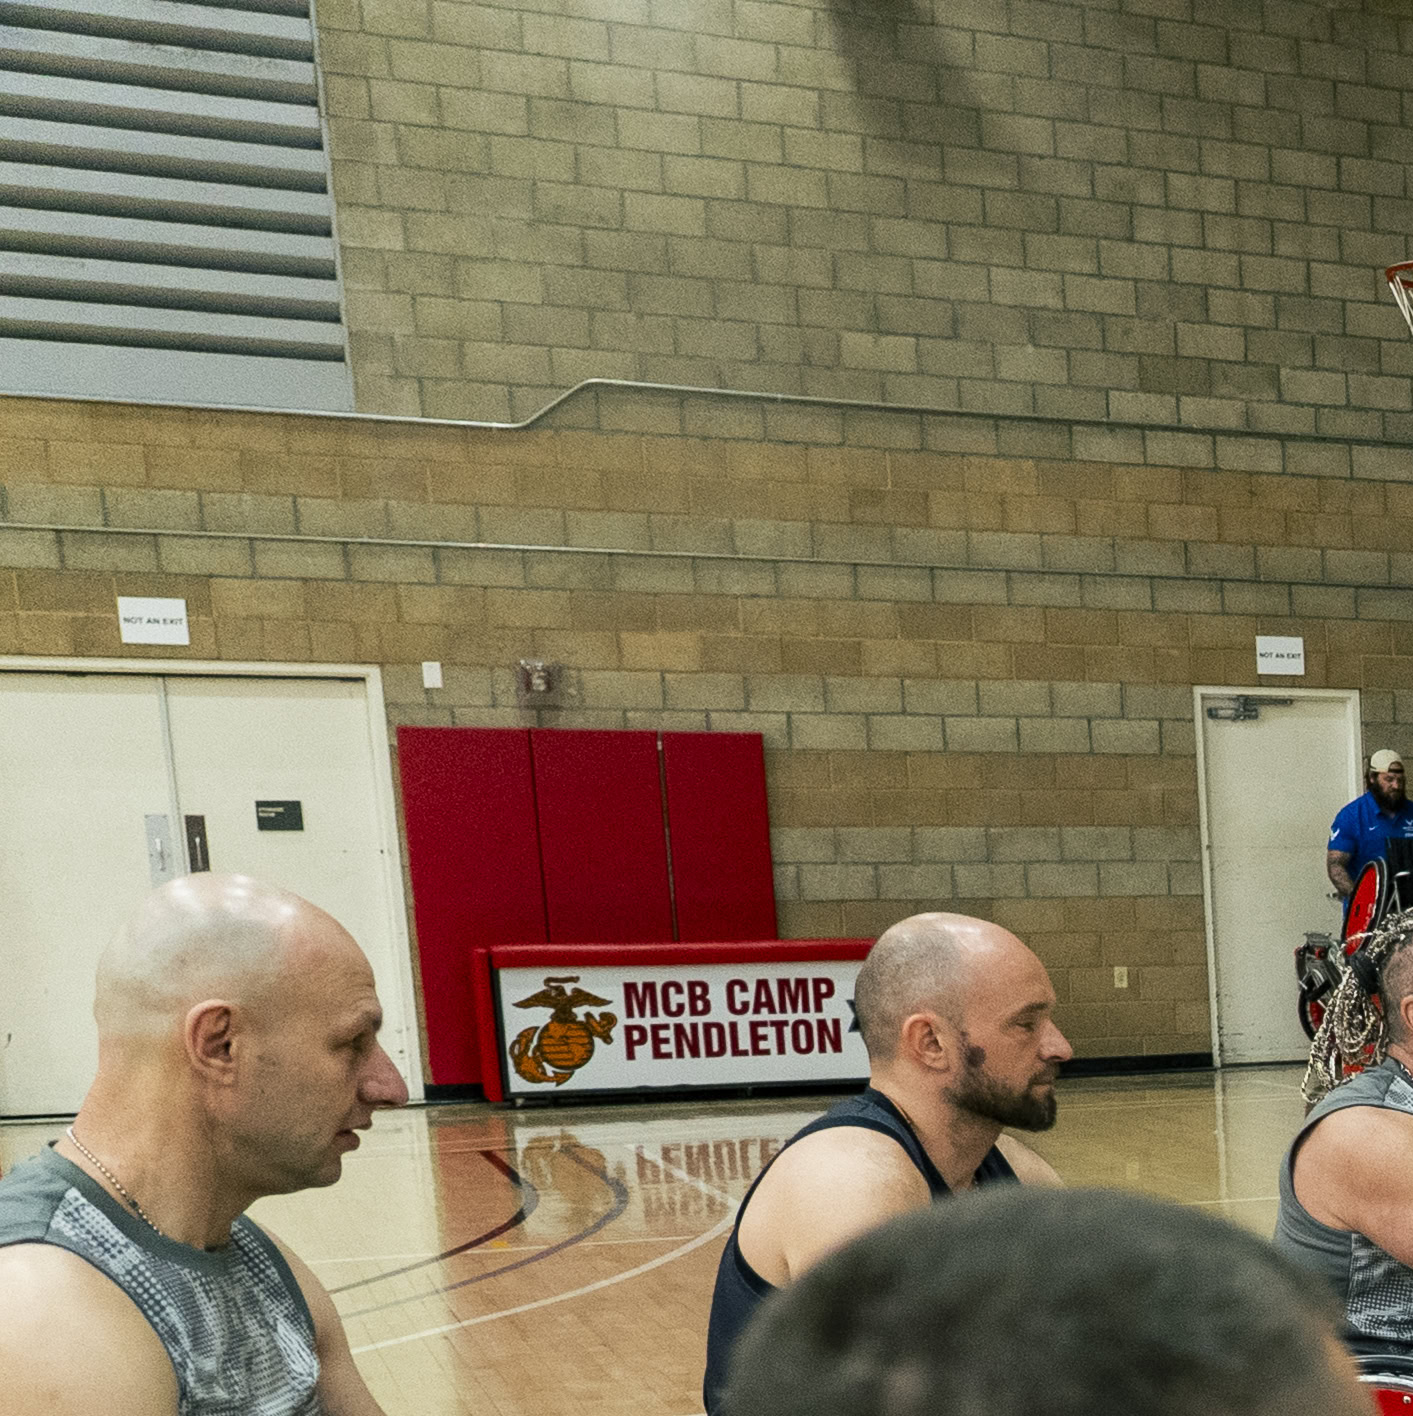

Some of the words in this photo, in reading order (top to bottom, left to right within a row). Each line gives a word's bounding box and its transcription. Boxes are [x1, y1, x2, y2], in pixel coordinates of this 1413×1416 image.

[123, 616, 143, 625] NOT
[146, 617, 160, 625] AN
[162, 617, 184, 626] EXIT
[1259, 651, 1273, 659] NOT
[1275, 651, 1285, 659] AN
[1286, 652, 1301, 660] EXIT
[622, 980, 712, 1019] MCB
[725, 977, 836, 1016] CAMP
[623, 1018, 843, 1061] PENDLETON
